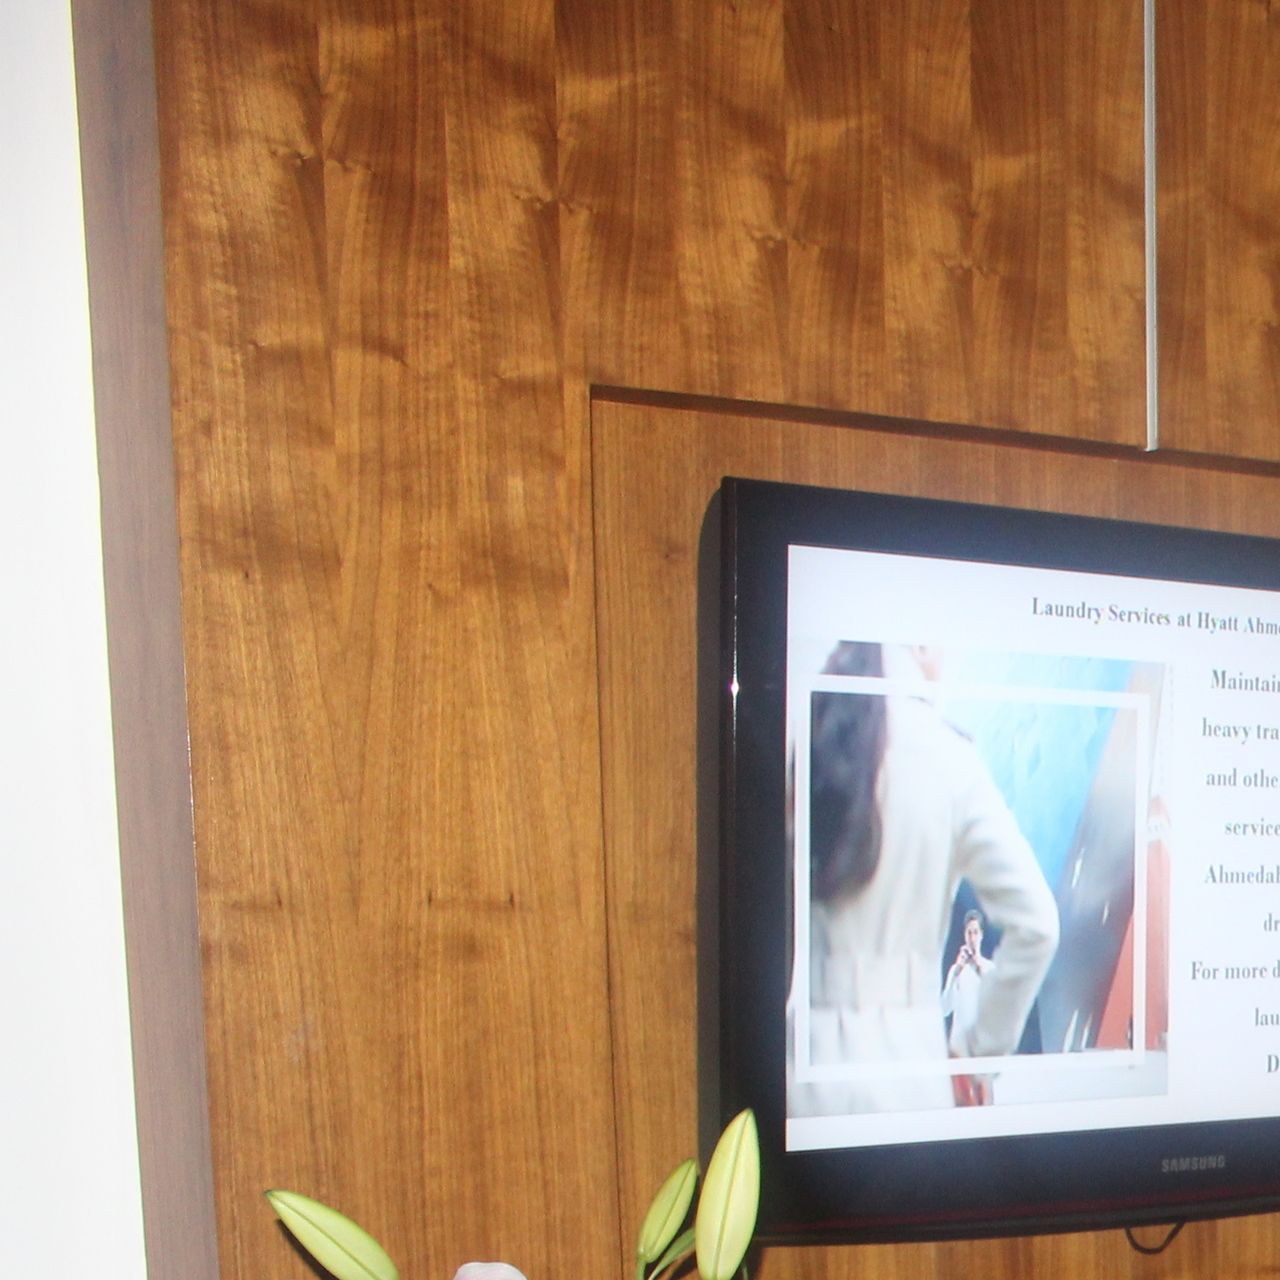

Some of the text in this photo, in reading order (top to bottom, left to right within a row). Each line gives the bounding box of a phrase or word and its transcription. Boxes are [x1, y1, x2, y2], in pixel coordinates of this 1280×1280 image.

[1032, 596, 1102, 625] Laundry
[1108, 604, 1171, 626] Services
[1177, 612, 1191, 628] at
[1197, 611, 1239, 635] Hyatt
[1202, 717, 1252, 745] heavy
[1206, 767, 1237, 787] and
[1191, 960, 1220, 981] For
[1224, 966, 1268, 980] more
[1161, 1155, 1225, 1173] SAMSUNG
